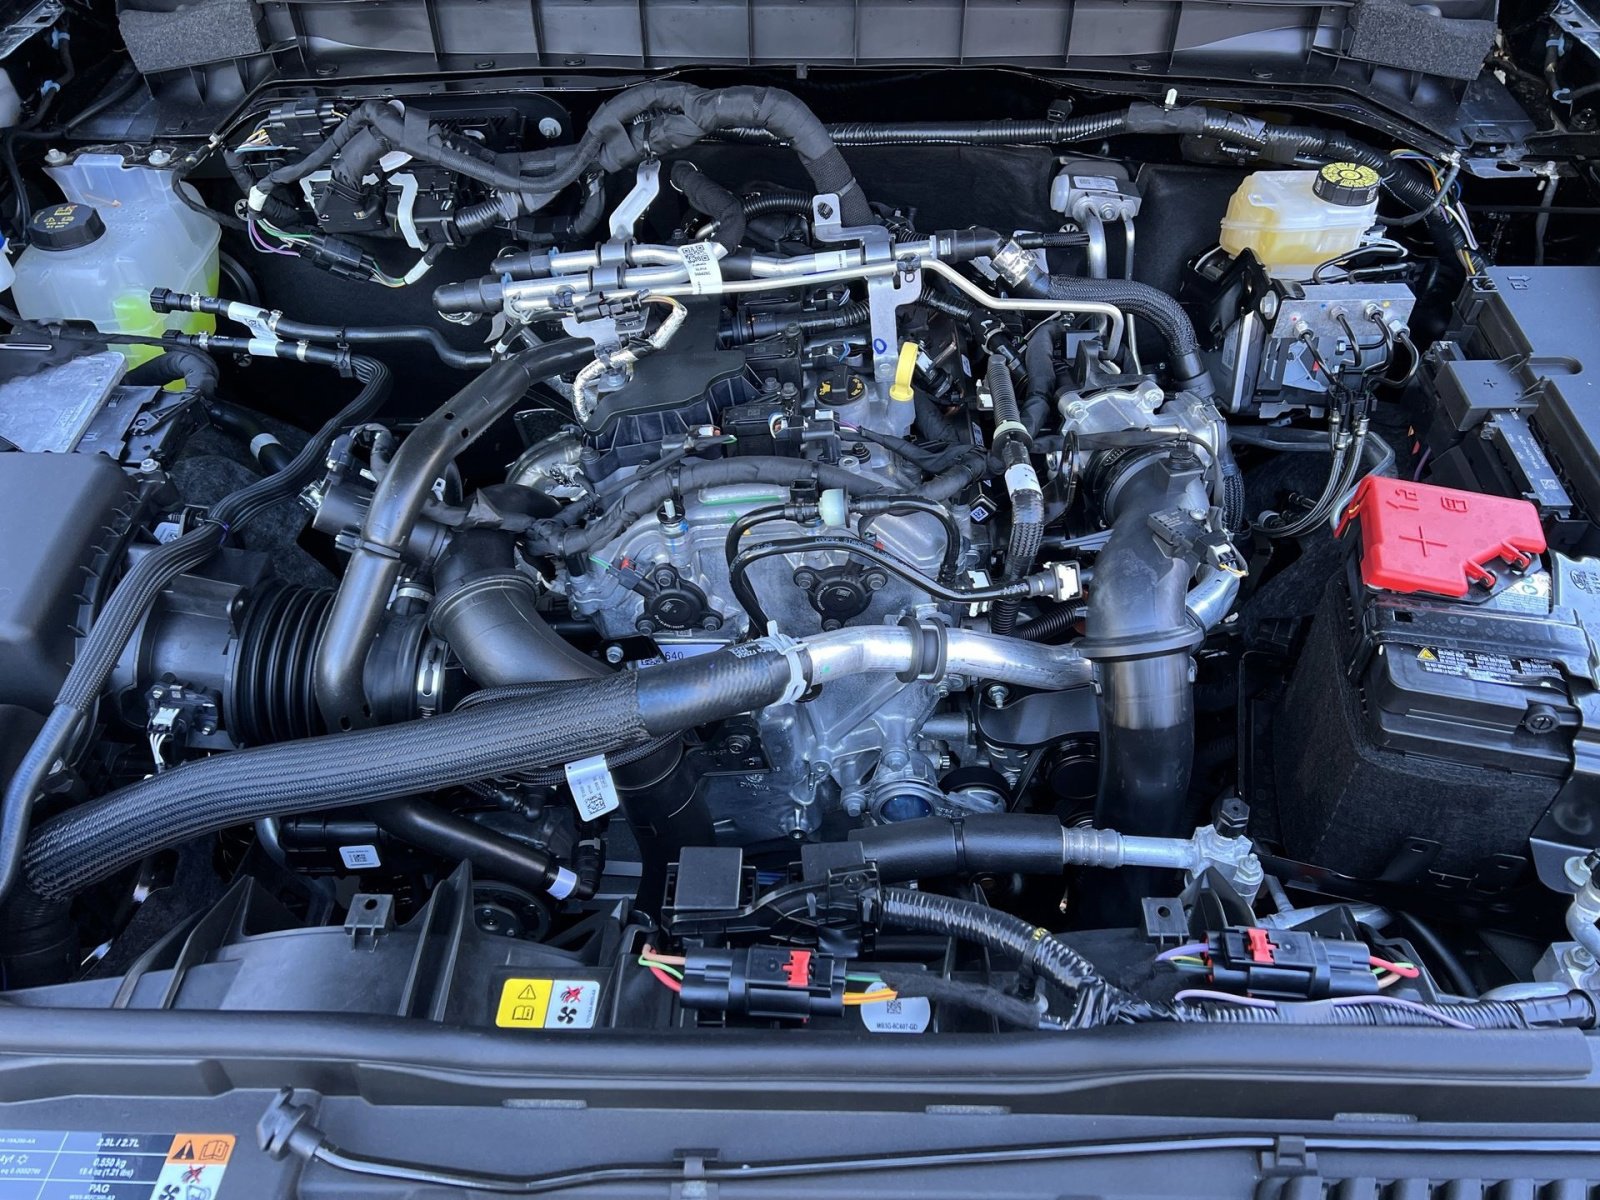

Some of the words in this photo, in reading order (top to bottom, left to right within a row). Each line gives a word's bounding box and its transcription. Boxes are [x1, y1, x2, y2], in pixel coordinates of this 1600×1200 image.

[96, 1138, 115, 1147] 2.3L
[120, 1138, 140, 1148] 2.7L
[93, 1157, 115, 1167] 0.550
[88, 1184, 110, 1193] PAG
